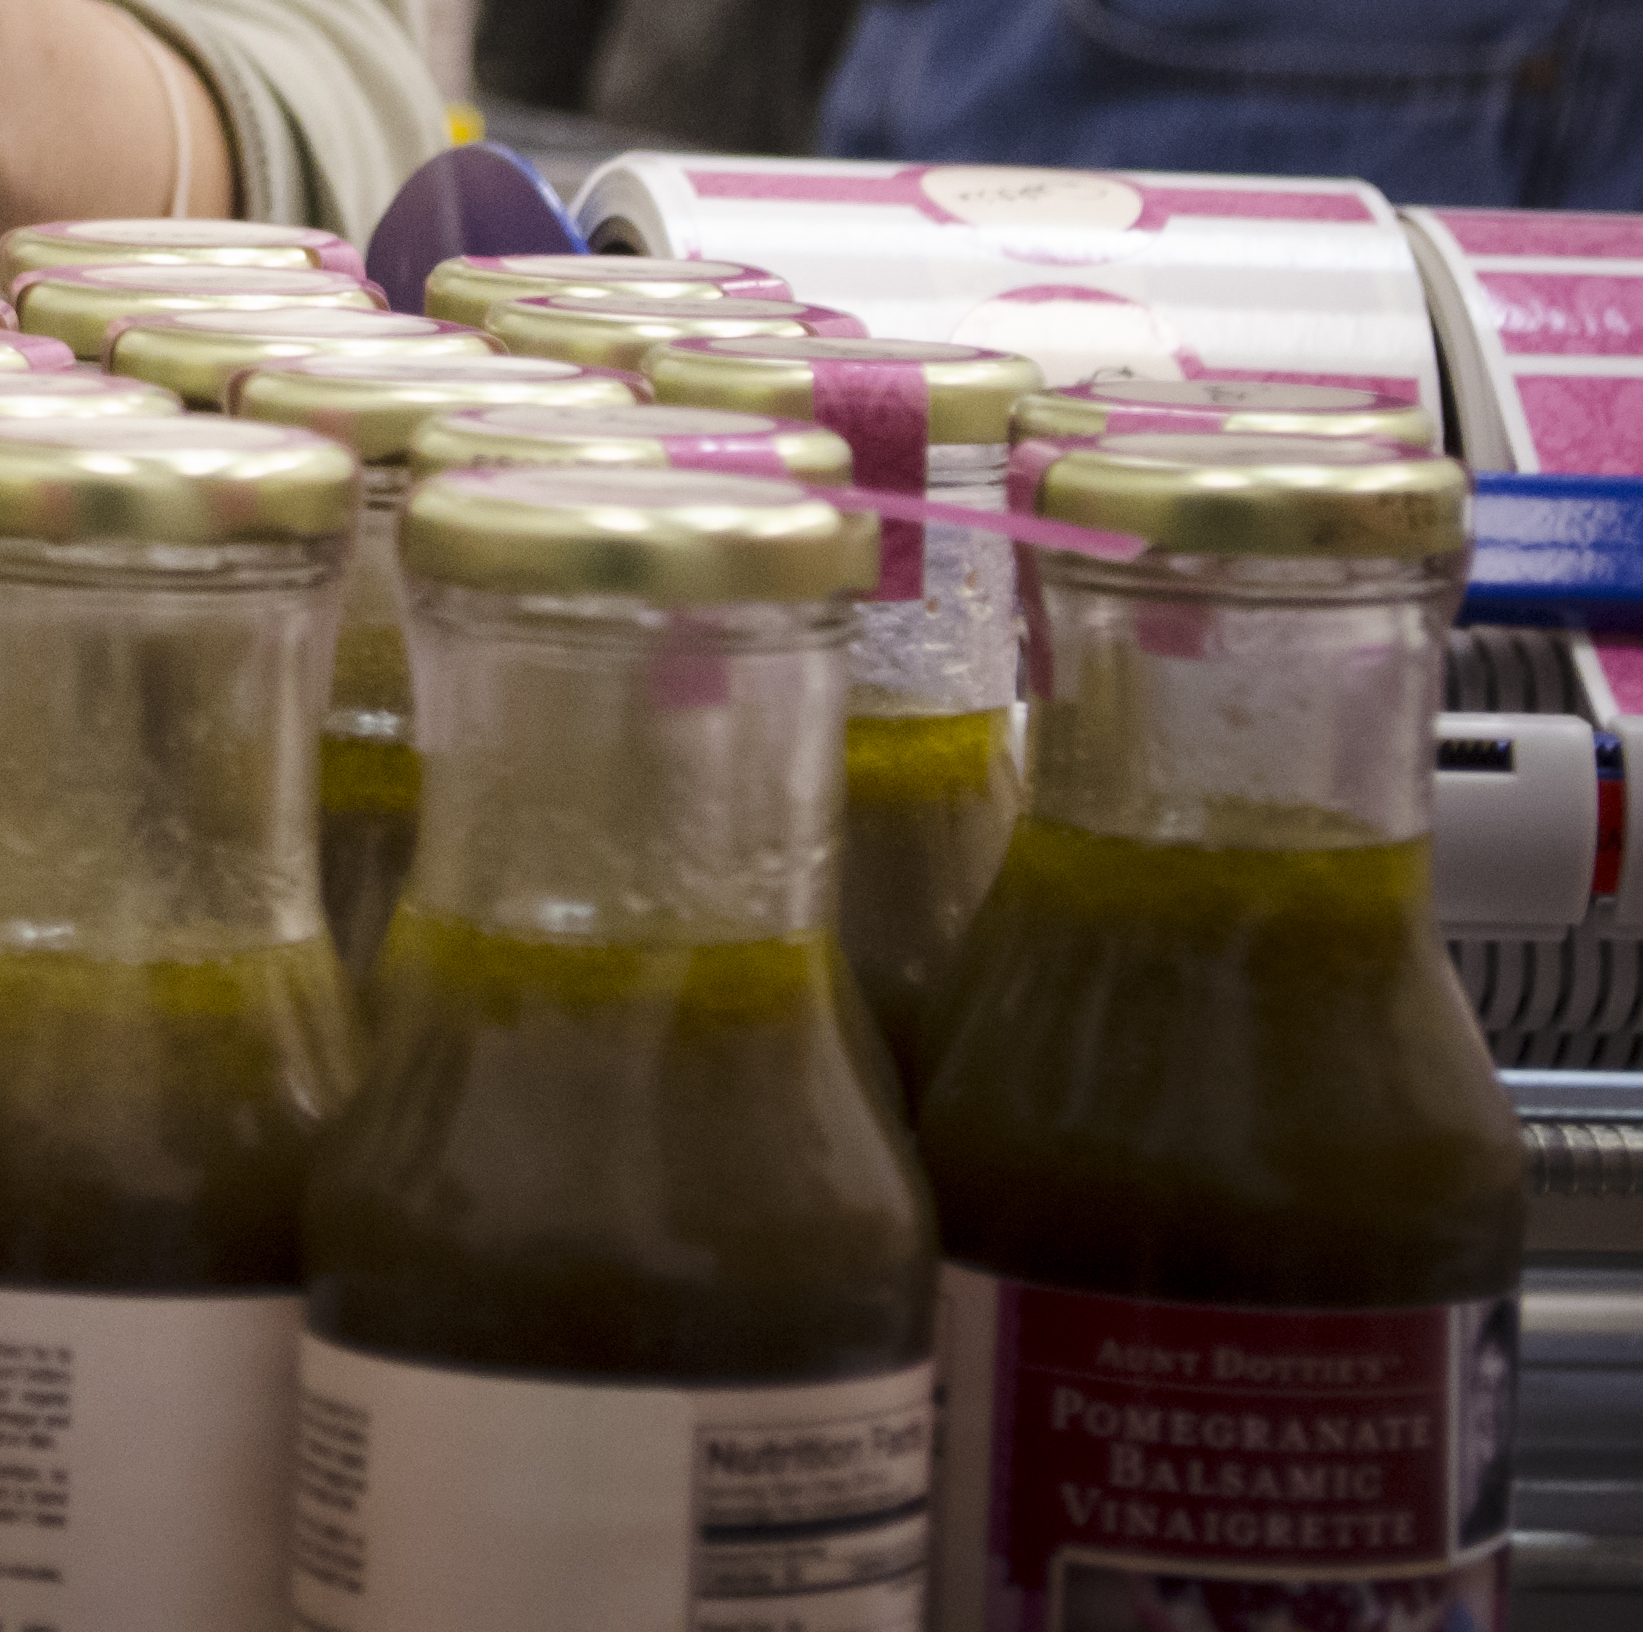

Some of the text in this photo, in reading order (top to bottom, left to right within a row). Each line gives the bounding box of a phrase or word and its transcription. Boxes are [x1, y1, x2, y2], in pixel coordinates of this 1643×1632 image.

[1096, 1336, 1200, 1376] AUNT
[1049, 1384, 1434, 1453] POMEGRANATE
[1107, 1442, 1384, 1503] BALSAMIC
[1059, 1481, 1418, 1549] VINAIGRETTE
